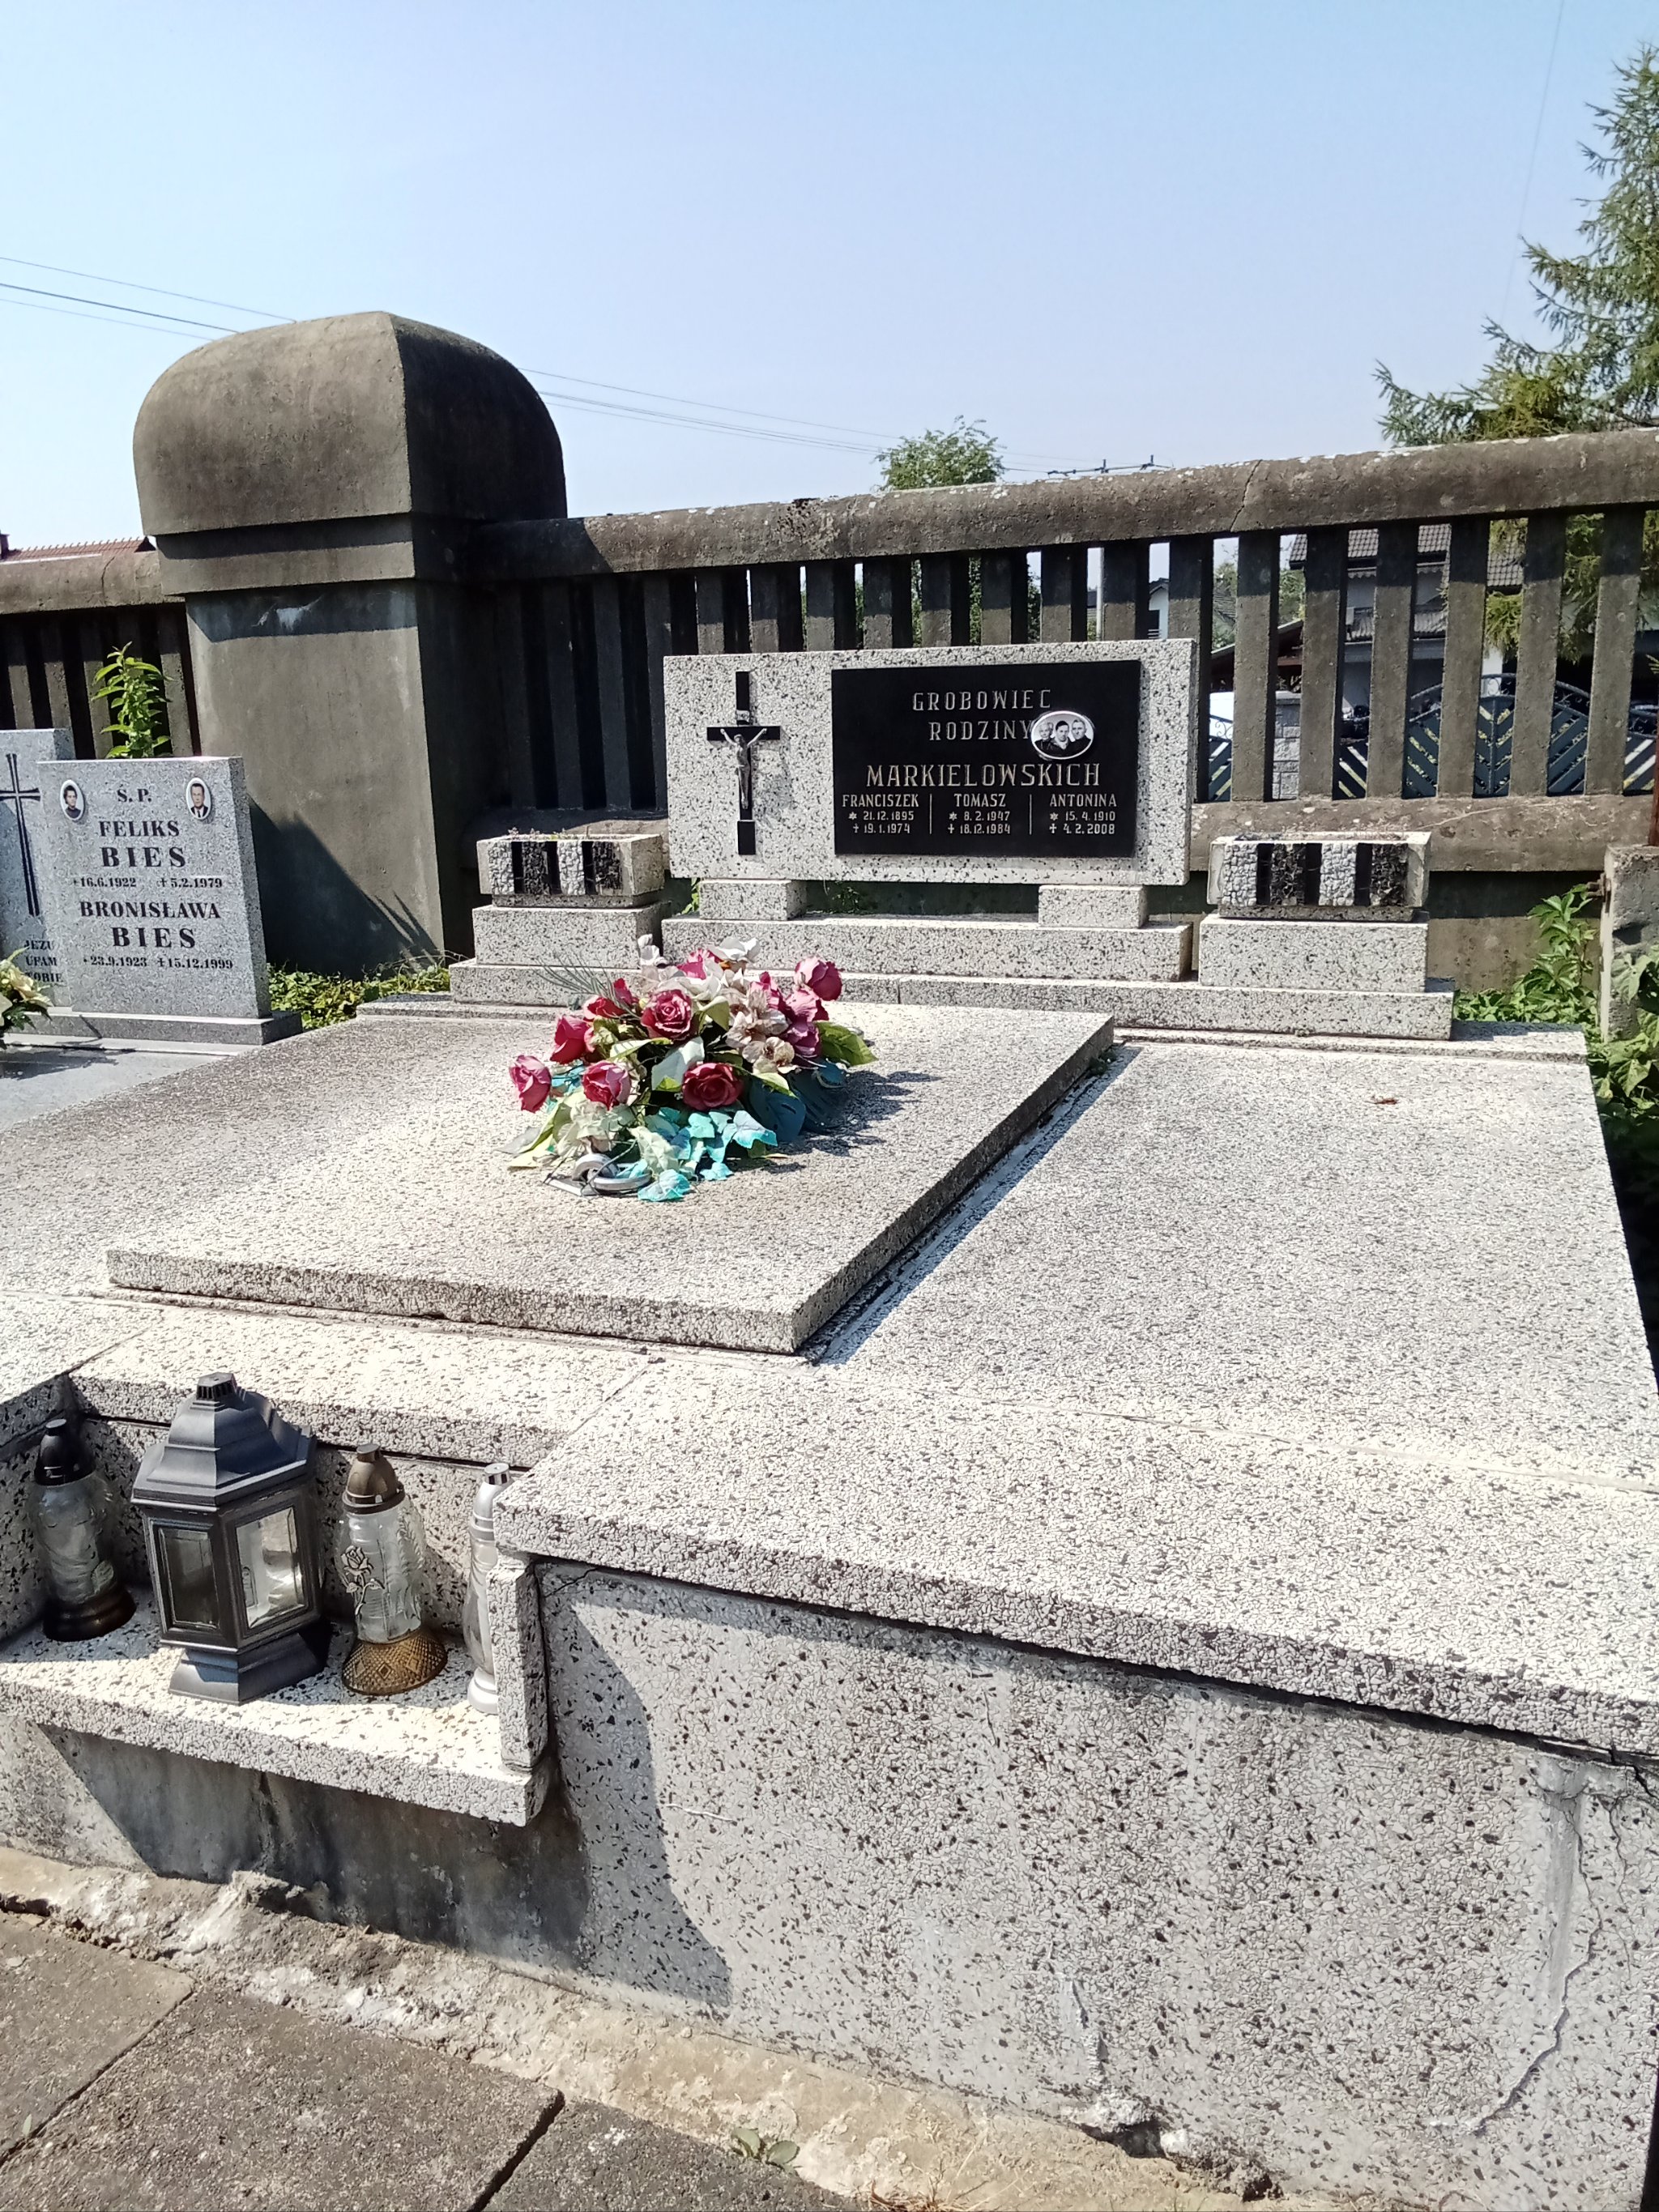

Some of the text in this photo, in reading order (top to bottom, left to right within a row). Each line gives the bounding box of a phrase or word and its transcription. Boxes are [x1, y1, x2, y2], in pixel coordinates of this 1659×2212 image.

[912, 689, 1051, 710] GROBOWIEC
[929, 720, 1034, 740] RODZINY
[867, 763, 1100, 787] MARKIELOWSKICH
[842, 794, 919, 808] FRANCISZEK
[953, 793, 1006, 808] TOMASZ
[1050, 793, 1117, 808] ANTONINA
[98, 820, 180, 837] FELIKS
[100, 846, 187, 867] BIES
[80, 901, 221, 918] BRONISŁAWA
[110, 927, 197, 948] BIES
[25, 955, 58, 966] UFAM
